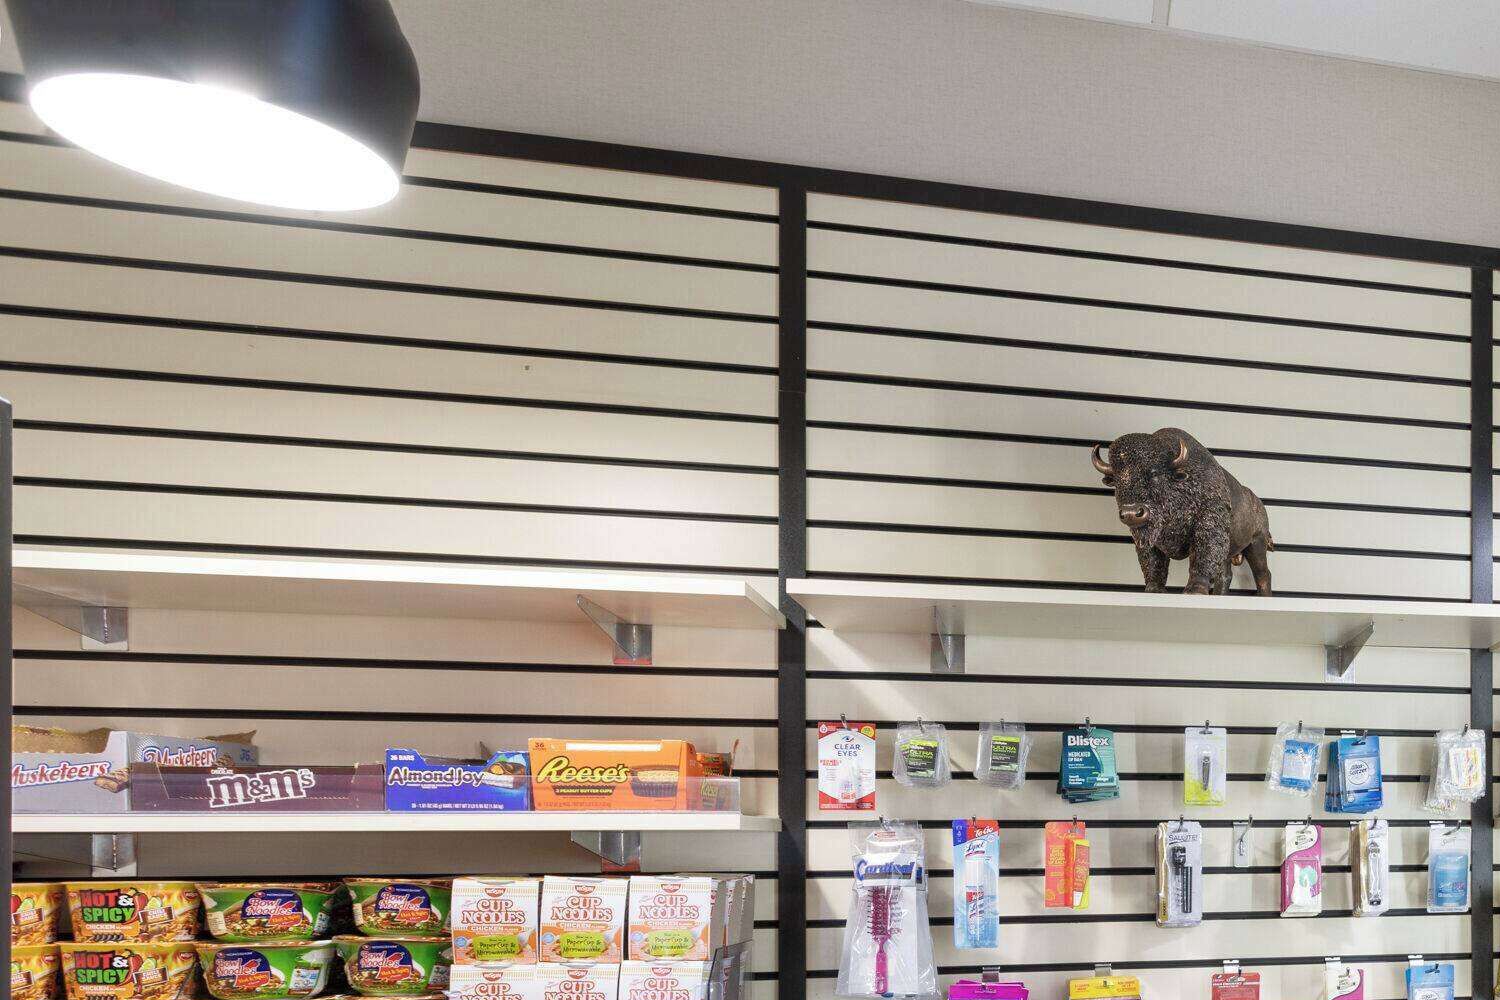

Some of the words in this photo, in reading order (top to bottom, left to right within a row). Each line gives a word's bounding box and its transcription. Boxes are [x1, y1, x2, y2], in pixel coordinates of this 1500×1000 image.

[834, 743, 861, 751] CLEAR
[1067, 735, 1110, 749] Blistex
[387, 765, 457, 785] Almond
[454, 766, 485, 787] Joy
[537, 756, 631, 784] Reese's
[80, 889, 119, 907] HOT
[118, 894, 135, 907] &
[477, 899, 514, 912] CUP
[566, 896, 603, 909] CUP
[653, 894, 688, 907] CUP
[83, 907, 135, 922] SPICY
[461, 910, 526, 925] NOODLES
[551, 907, 613, 922] NOODLES
[638, 905, 700, 920] NOODLES
[74, 951, 115, 969] HOT
[112, 956, 129, 968] &
[76, 968, 129, 984] SPICY
[475, 982, 511, 996] CUP
[559, 980, 595, 994] CUP
[643, 977, 679, 991] CUP
